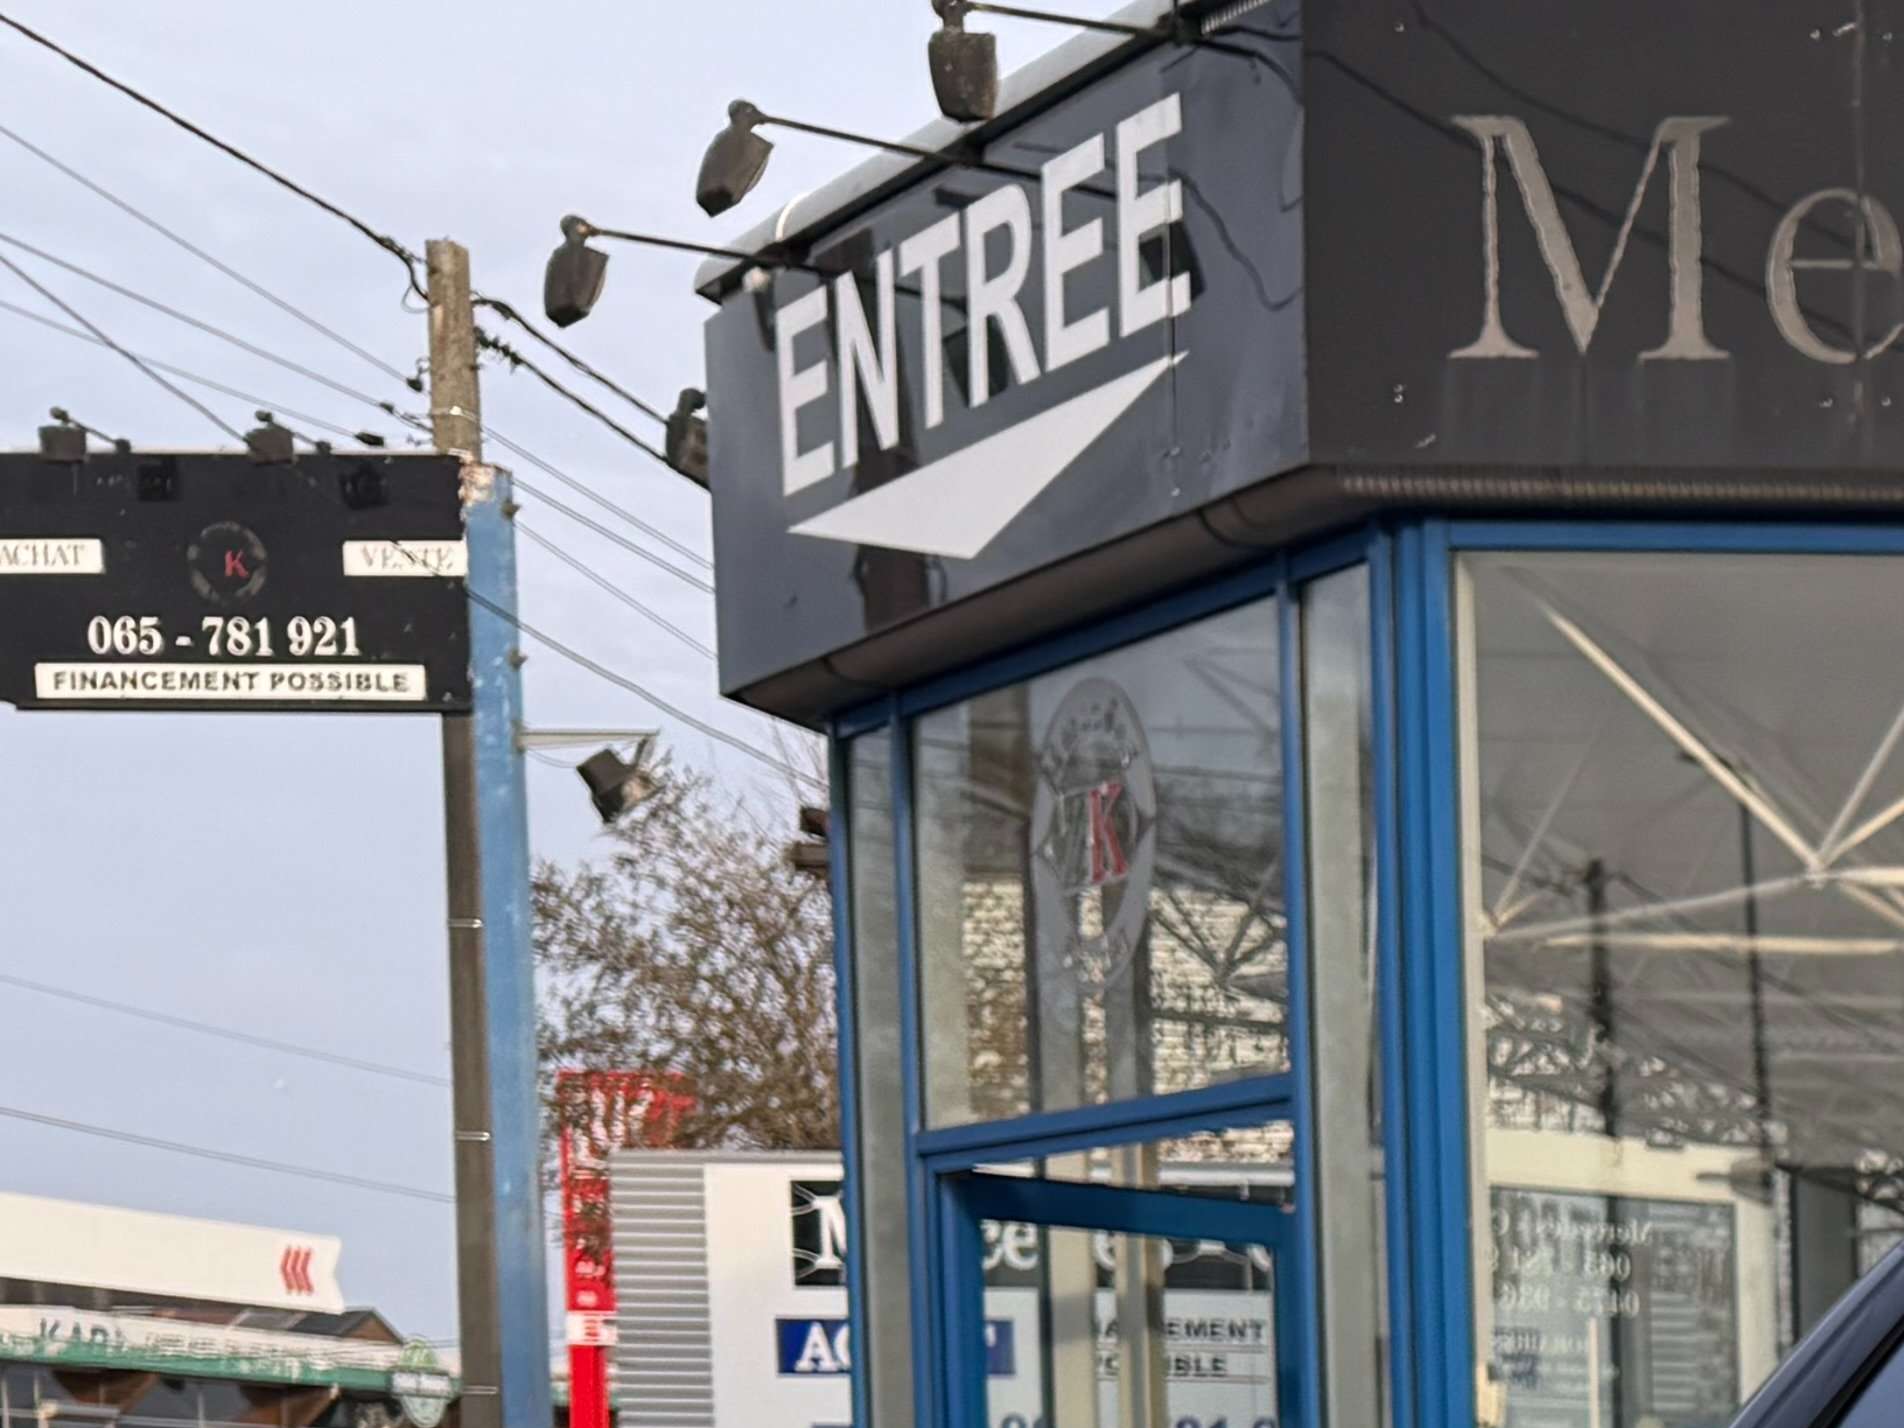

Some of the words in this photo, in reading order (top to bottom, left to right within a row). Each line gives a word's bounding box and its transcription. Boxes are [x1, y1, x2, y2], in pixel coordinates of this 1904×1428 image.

[775, 92, 1191, 497] ENTREE
[0, 543, 87, 567] ACHAT
[87, 614, 164, 656] 065
[201, 615, 275, 657] 781
[286, 615, 362, 657] 921
[52, 671, 259, 691] FINANCEMENT
[270, 671, 411, 693] POSSIBLE
